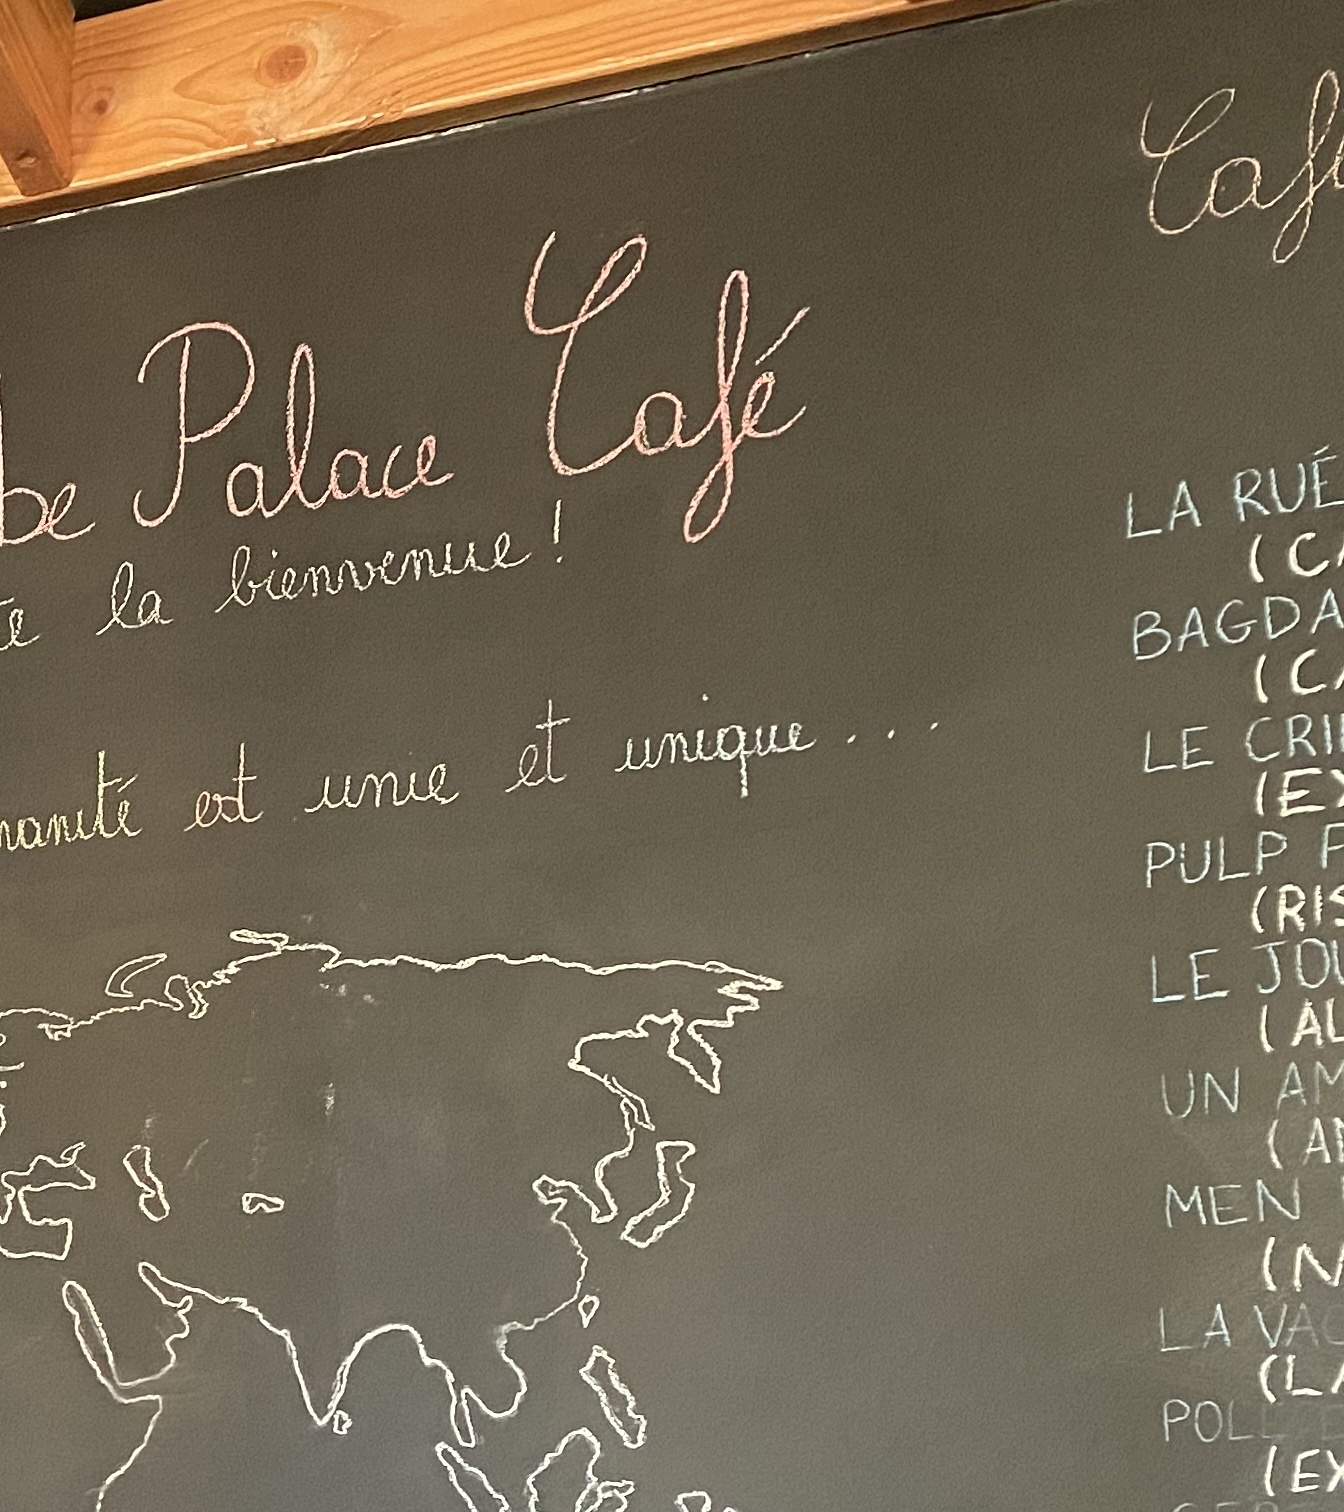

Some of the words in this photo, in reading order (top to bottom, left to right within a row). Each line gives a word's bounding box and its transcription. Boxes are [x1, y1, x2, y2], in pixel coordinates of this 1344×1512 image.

[133, 322, 454, 528] Palace
[524, 230, 811, 543] Café
[1126, 480, 1201, 538] LA
[97, 561, 174, 636] la
[216, 531, 532, 613] bienvenue
[1133, 588, 1344, 661] BAGDA
[184, 742, 263, 832] est
[303, 752, 459, 813] unie
[505, 698, 571, 794] et
[1144, 726, 1214, 773] LE
[1245, 712, 1344, 762] CRI
[1146, 830, 1288, 889] PULP
[1151, 949, 1230, 1003] LE
[1161, 1065, 1241, 1119] UN
[1164, 1177, 1300, 1228] MEN
[1159, 1303, 1232, 1353] LA
